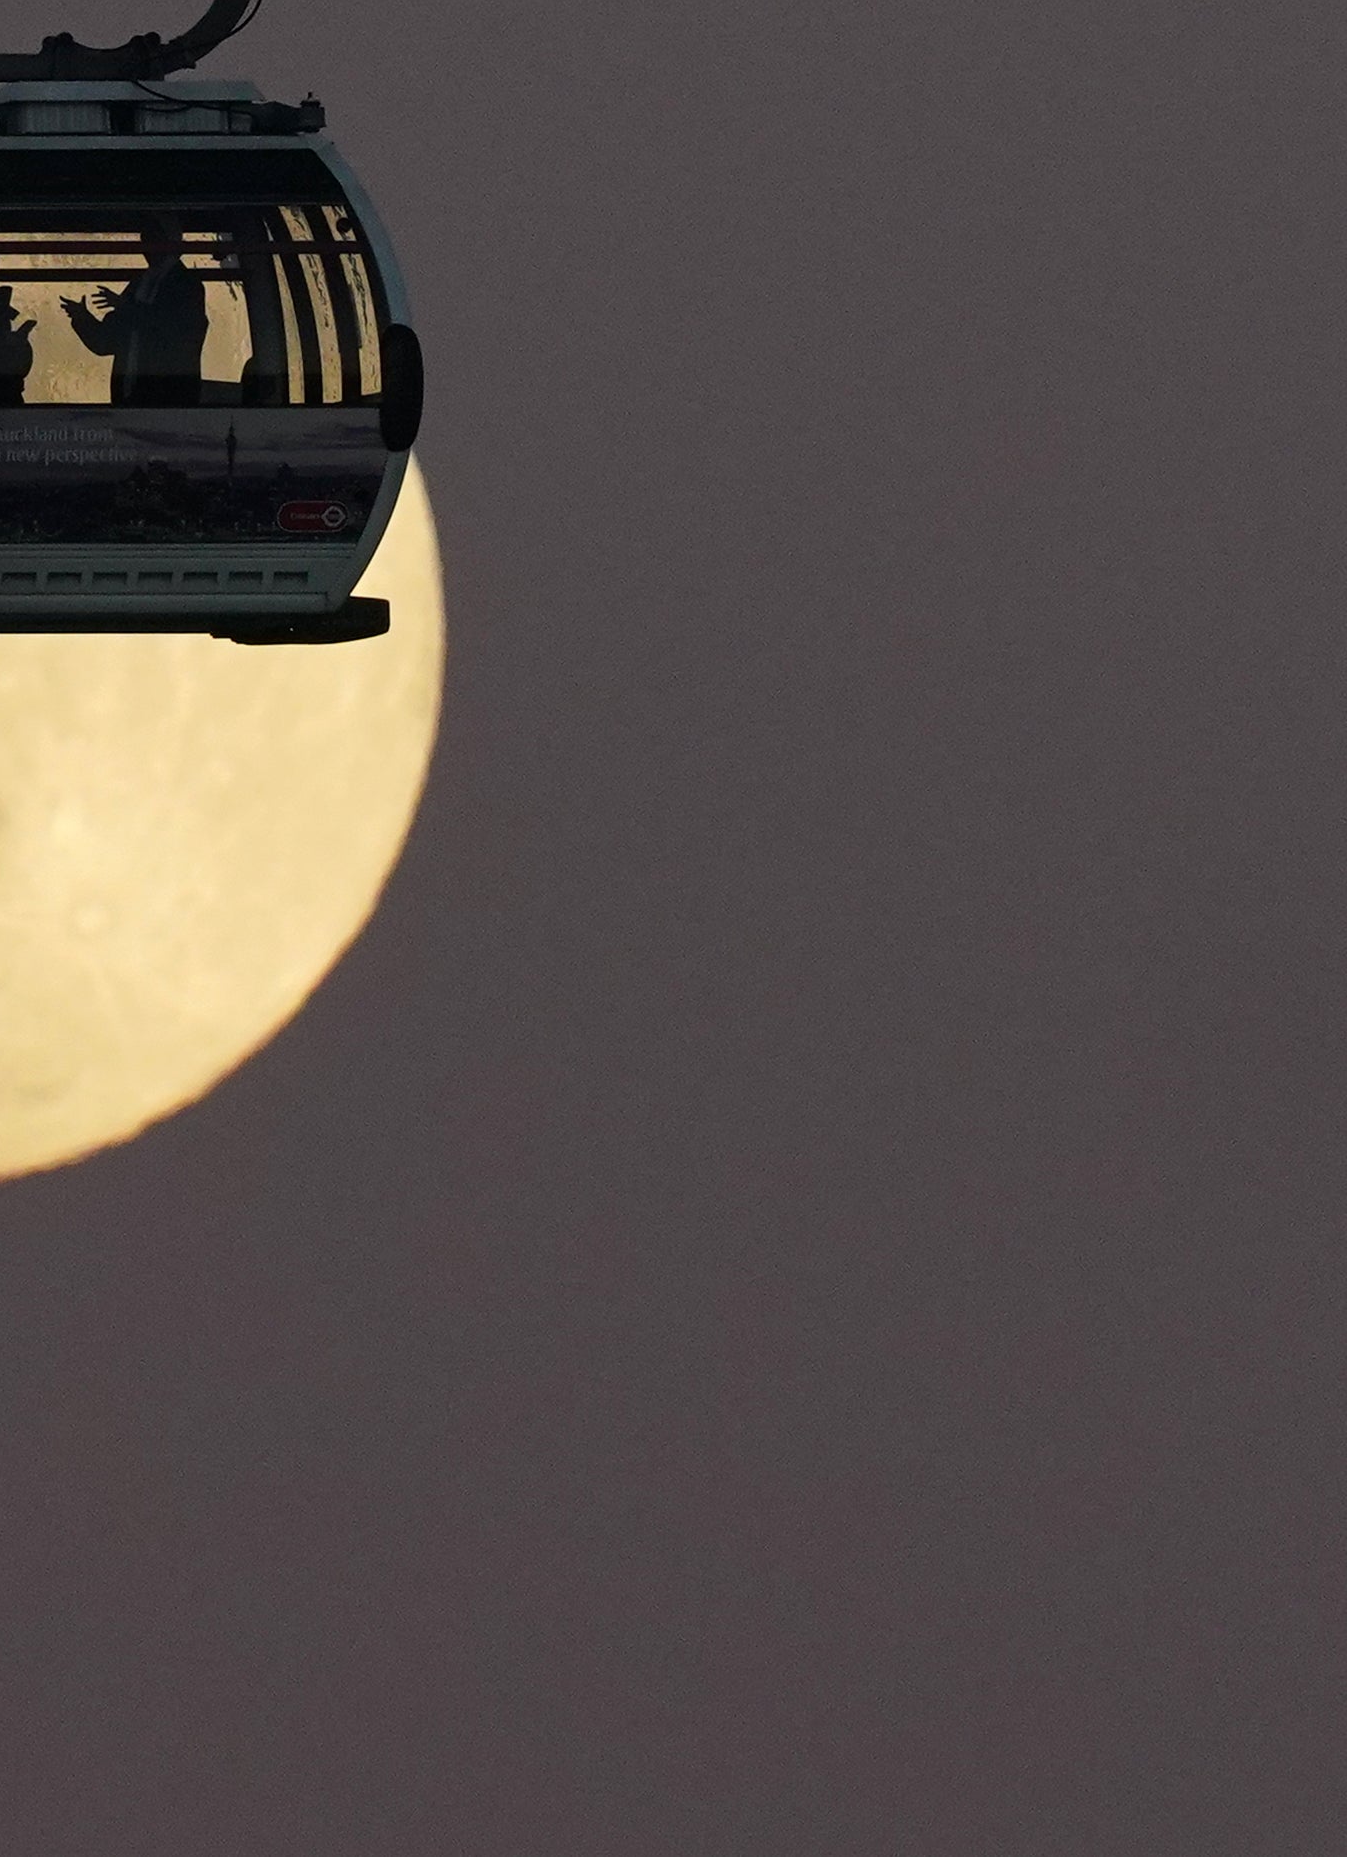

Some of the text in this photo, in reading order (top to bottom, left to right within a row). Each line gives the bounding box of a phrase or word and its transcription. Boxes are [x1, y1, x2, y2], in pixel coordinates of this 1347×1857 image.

[72, 427, 114, 442] from
[5, 449, 39, 463] new
[44, 446, 139, 467] perspective
